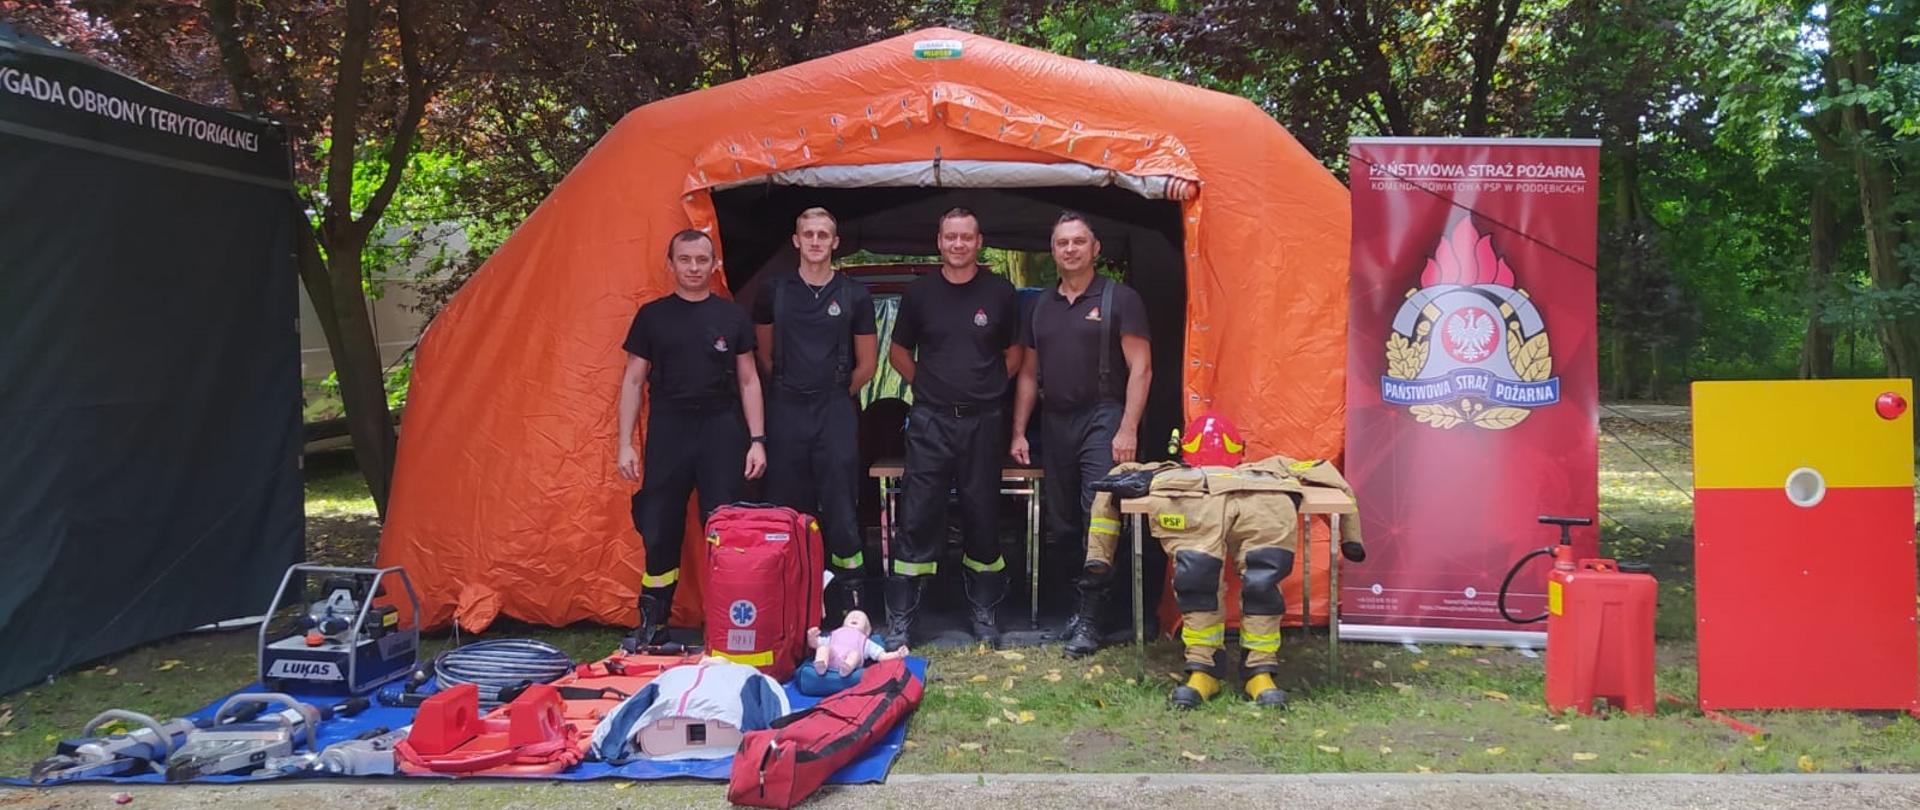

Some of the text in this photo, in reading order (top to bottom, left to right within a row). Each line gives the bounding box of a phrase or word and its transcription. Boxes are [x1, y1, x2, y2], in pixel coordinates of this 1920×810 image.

[68, 86, 147, 126] OBRONY
[149, 107, 258, 152] TERYTORIALNEJ
[1369, 161, 1585, 179] PAŃSTWOWA STRAŻ POŻARNA
[1371, 181, 1585, 195] KOMENDA POWIATOWA PSP W PODDĘBICACH
[1385, 374, 1554, 402] PAŃSTWOWA STRAŻ POŻARNA
[1163, 516, 1181, 527] PSP
[282, 662, 330, 677] LUKAS
